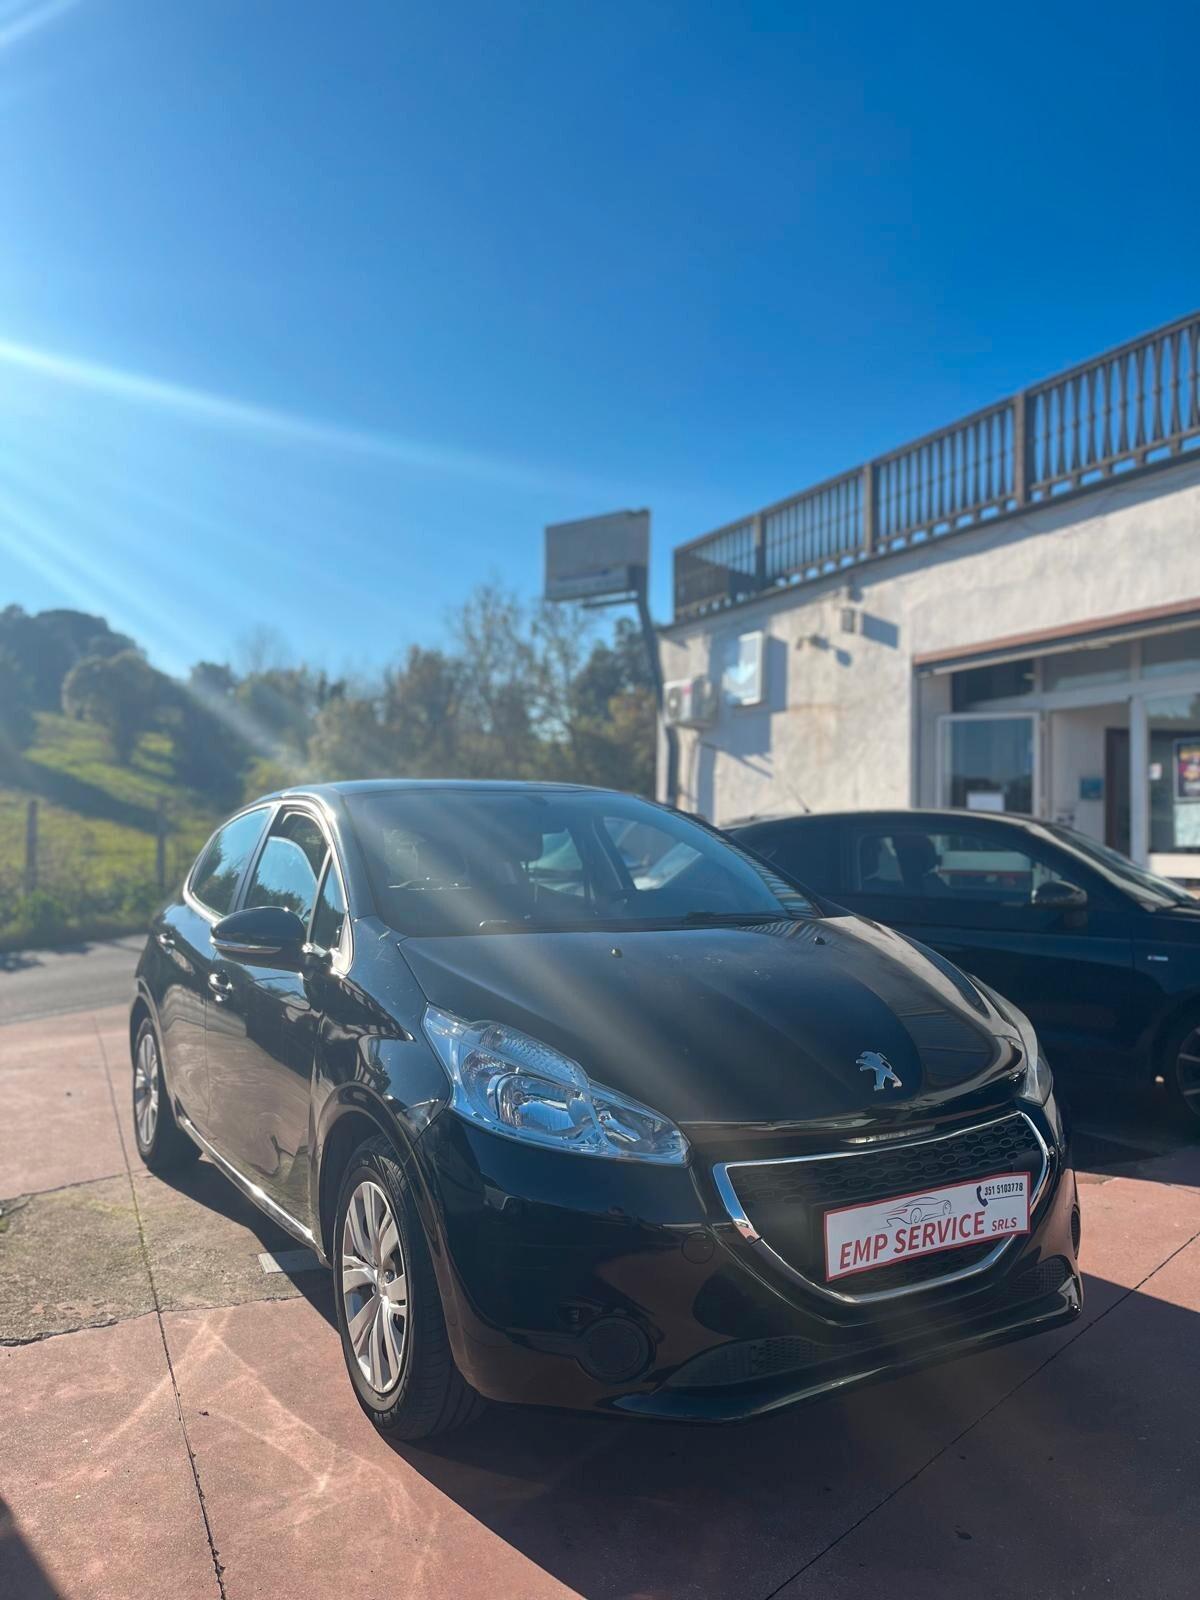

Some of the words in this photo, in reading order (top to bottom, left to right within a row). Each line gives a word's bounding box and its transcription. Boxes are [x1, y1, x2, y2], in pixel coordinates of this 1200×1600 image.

[984, 1186, 995, 1196] 351
[839, 1233, 888, 1270] EMP
[893, 1210, 986, 1254] SERVICE
[991, 1217, 1018, 1232] SRLS
